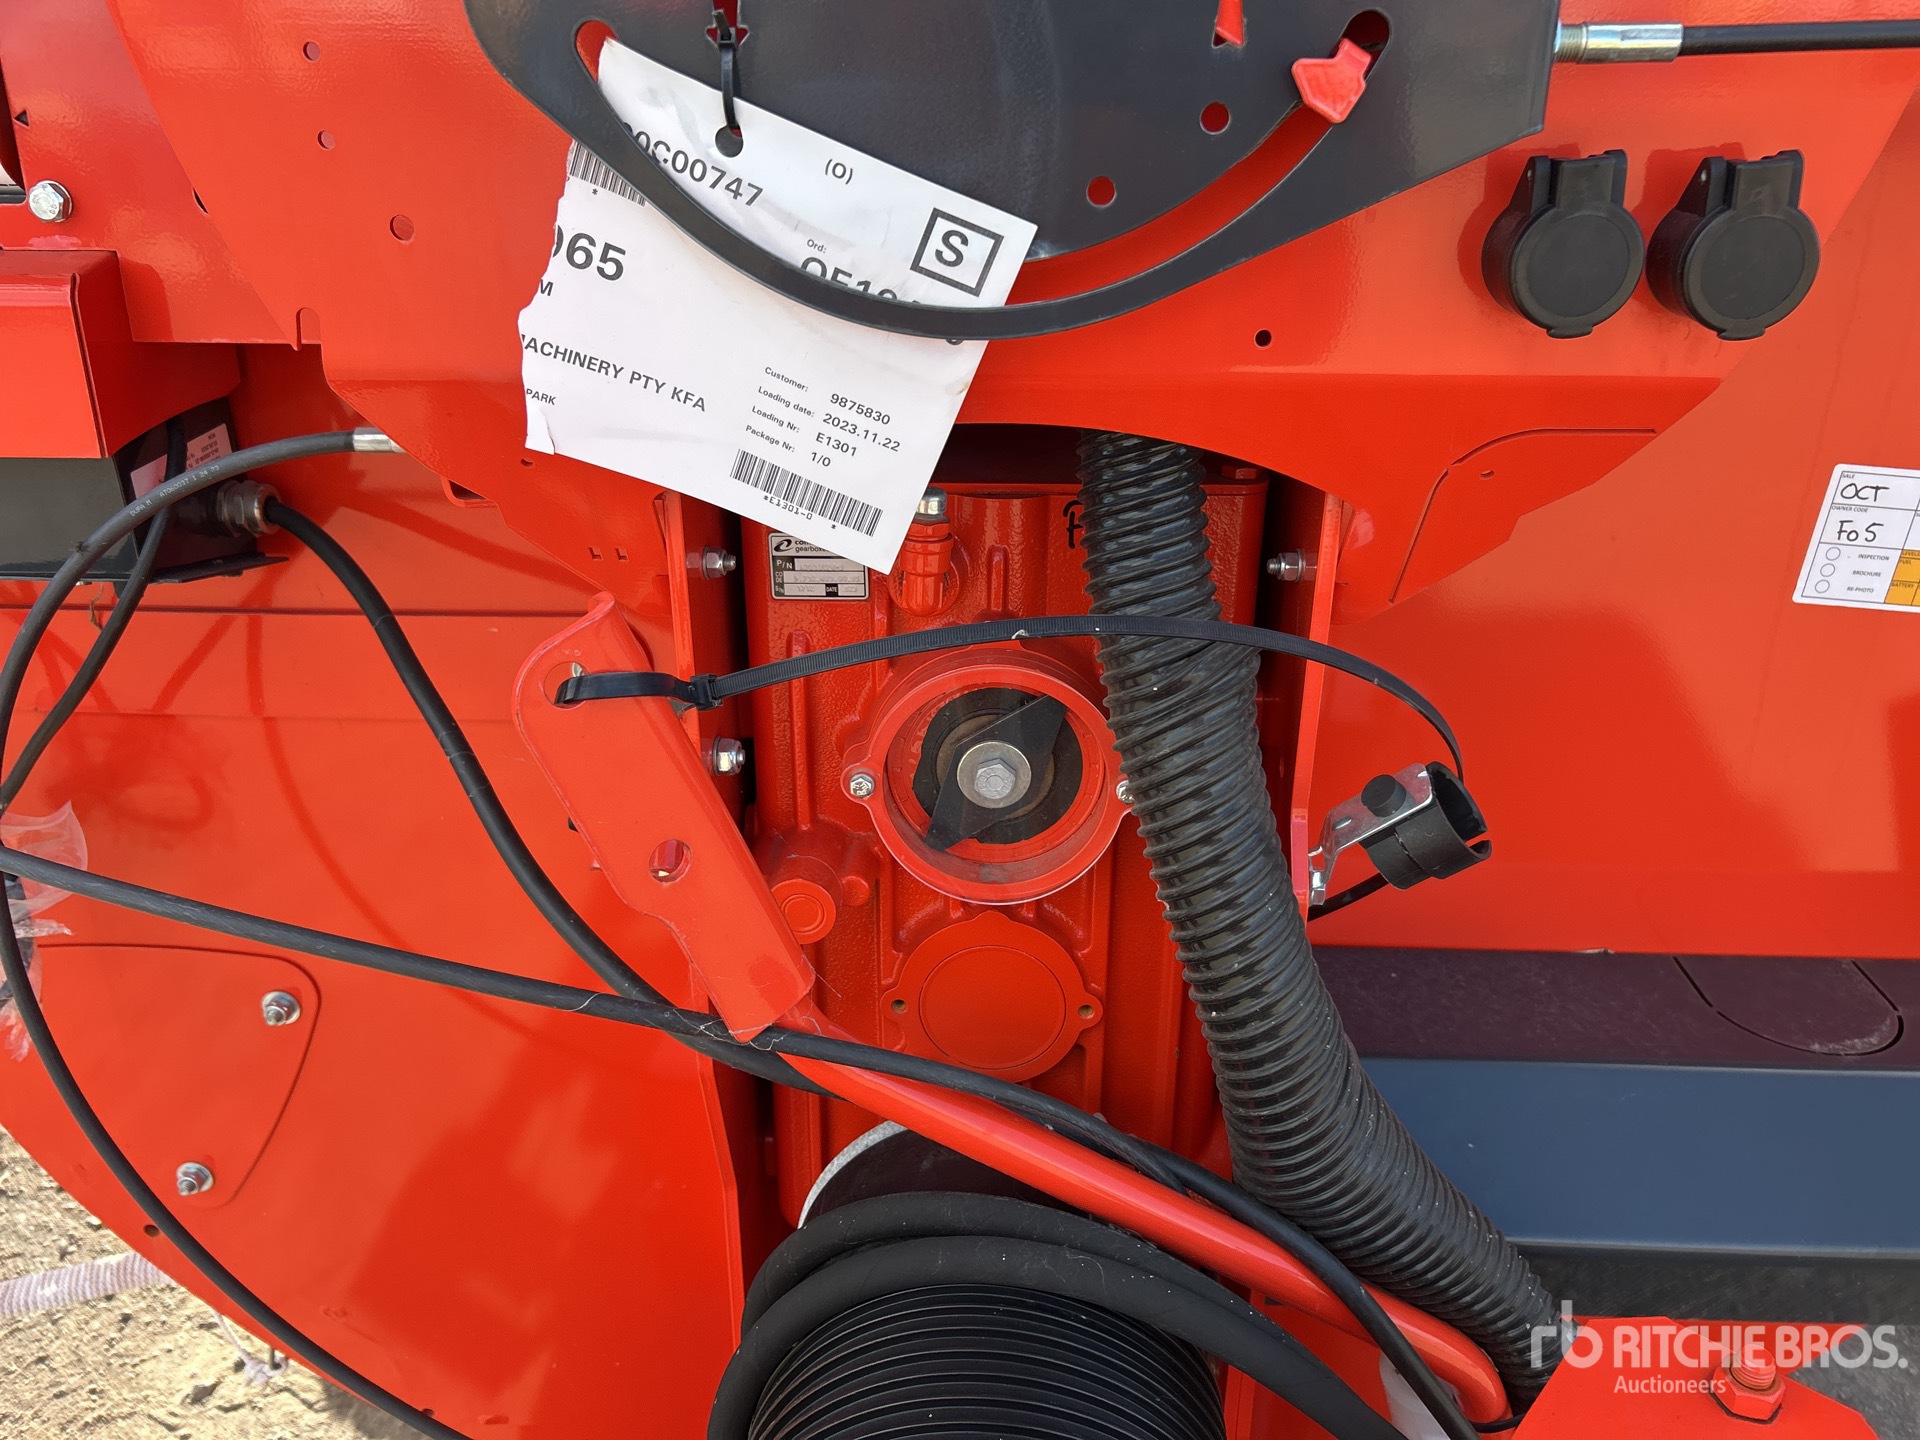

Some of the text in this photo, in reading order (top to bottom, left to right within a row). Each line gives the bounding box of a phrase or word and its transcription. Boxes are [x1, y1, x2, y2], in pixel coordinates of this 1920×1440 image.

[623, 122, 764, 206] 0C00747
[806, 238, 827, 254] Ord:
[935, 229, 969, 268] S
[521, 334, 625, 379] ACHINERY
[526, 388, 557, 406] PARK
[629, 371, 667, 394] PTY
[764, 366, 891, 426] Customer: 9875830
[671, 386, 707, 412] KFA
[751, 405, 858, 457] Loading Nr: E1301
[758, 385, 901, 452] Loading date: 2023.11.22
[745, 424, 780, 446] Package
[782, 441, 796, 453] Nr:
[1840, 483, 1890, 502] OCT
[776, 559, 793, 569] P/N
